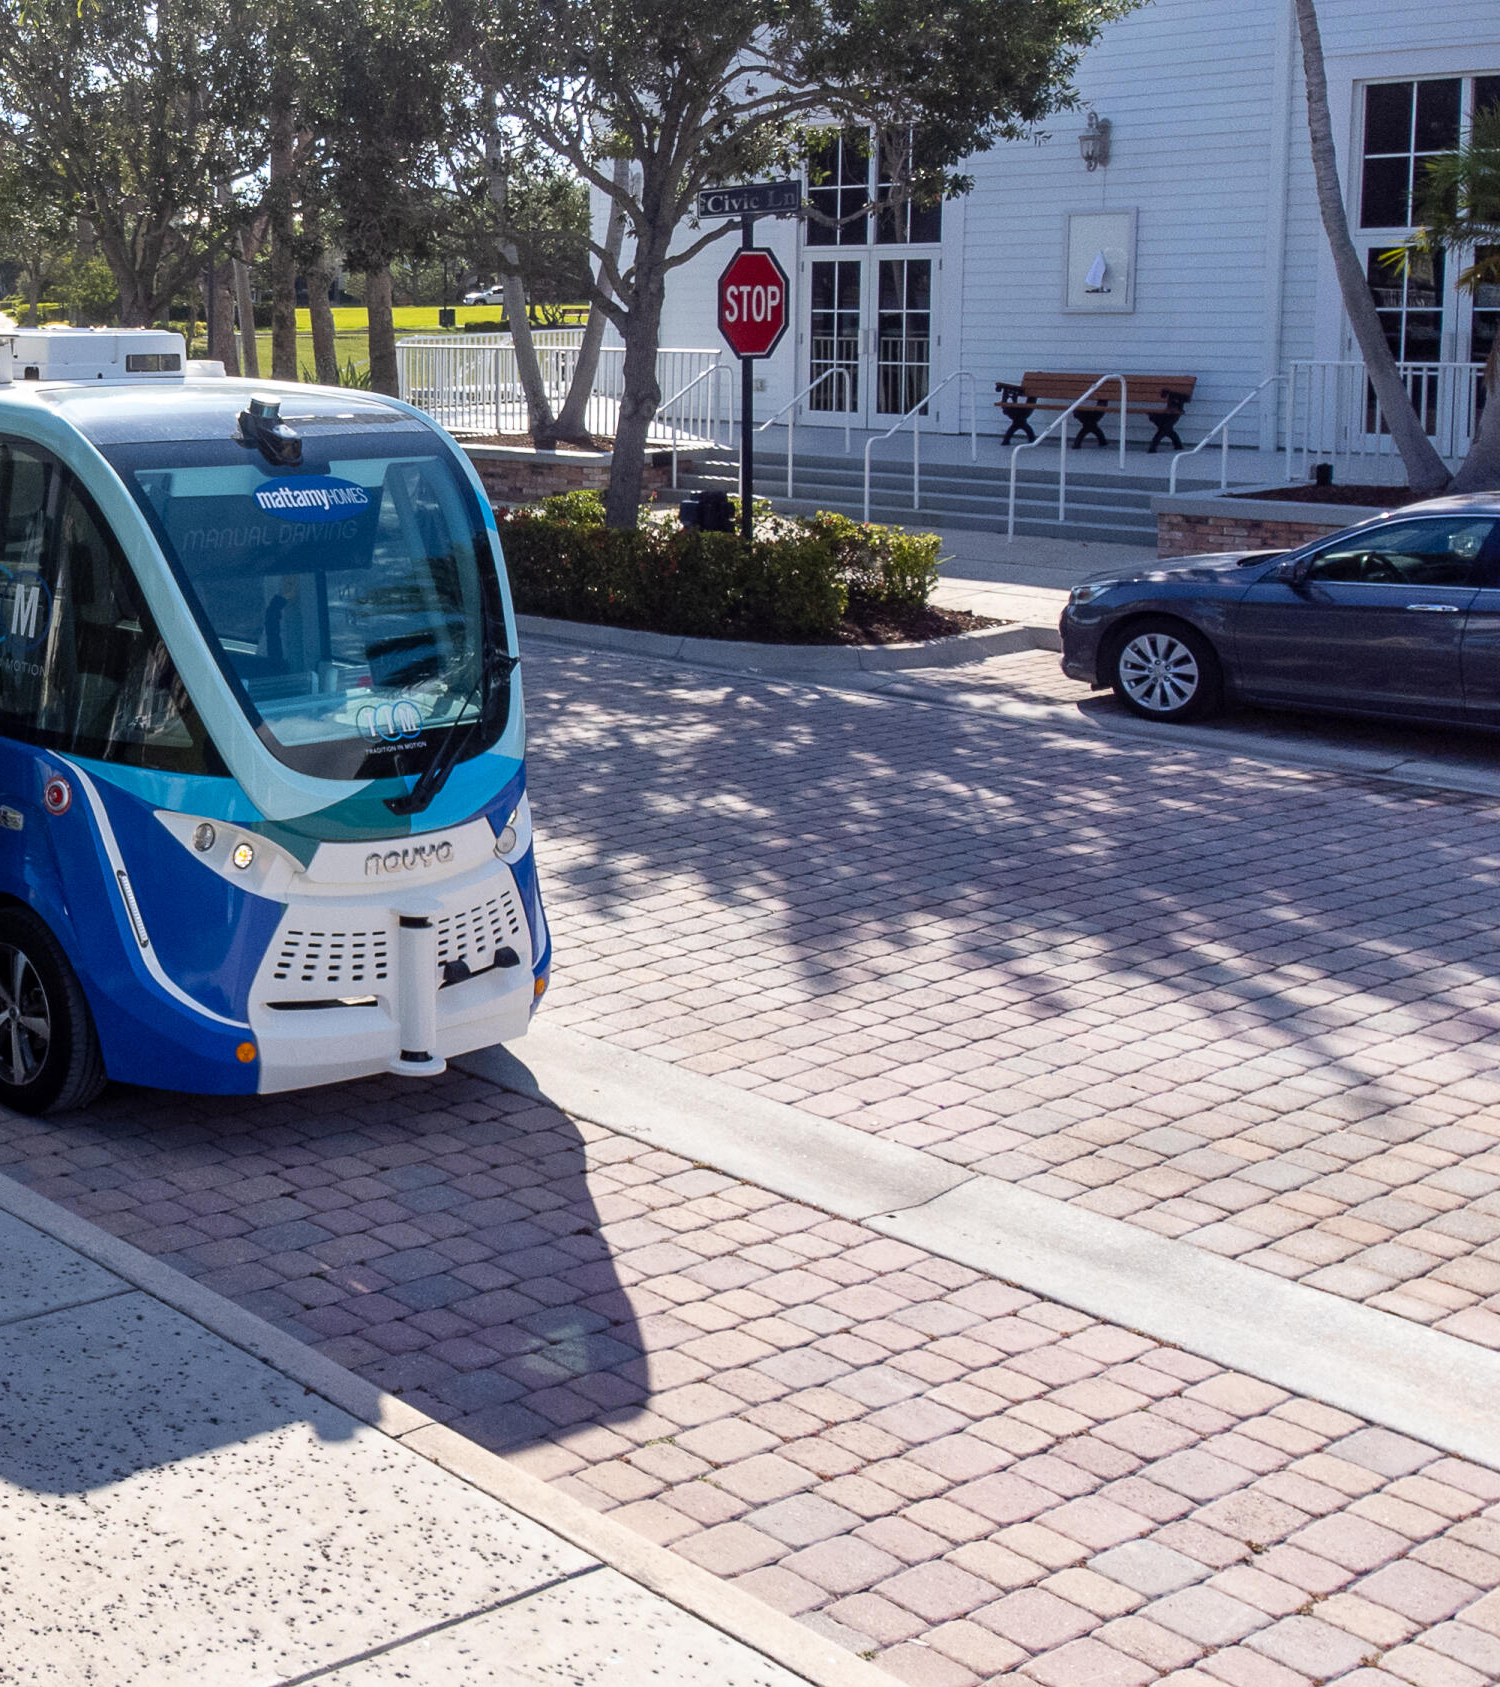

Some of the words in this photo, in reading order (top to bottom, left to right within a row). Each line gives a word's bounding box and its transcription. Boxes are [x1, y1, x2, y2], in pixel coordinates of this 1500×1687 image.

[707, 194, 760, 213] Civic
[766, 190, 796, 208] Ln
[725, 285, 780, 322] STOP
